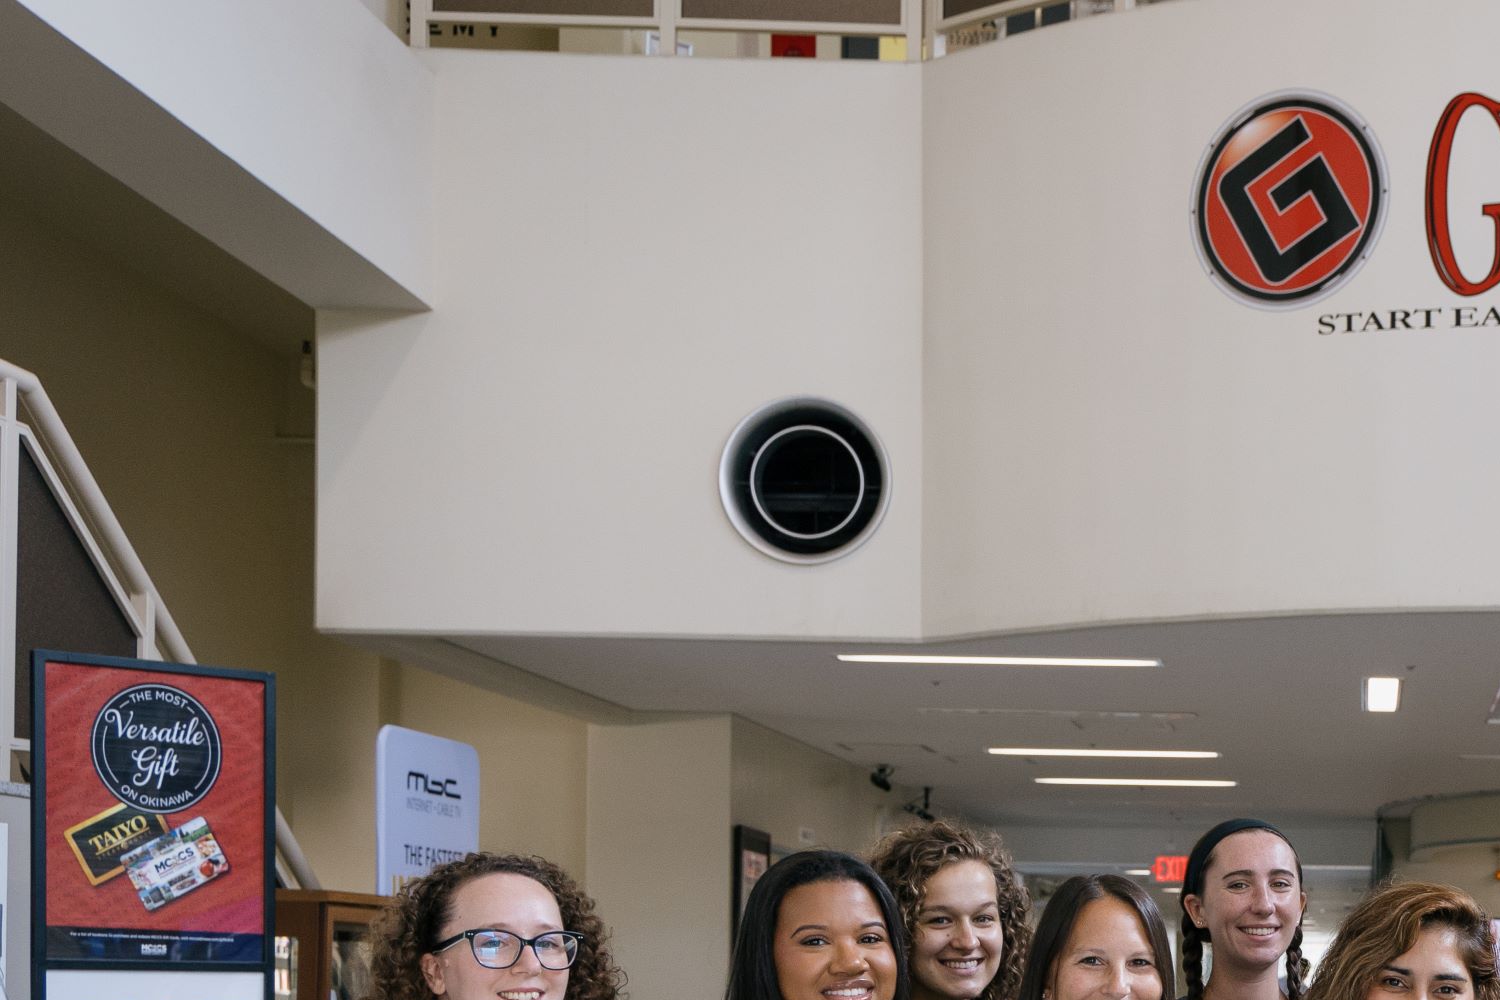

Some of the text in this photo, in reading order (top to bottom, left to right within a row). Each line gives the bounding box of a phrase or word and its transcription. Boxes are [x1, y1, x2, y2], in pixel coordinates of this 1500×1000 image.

[1318, 307, 1441, 335] START
[129, 690, 188, 709] THE MOST
[105, 709, 205, 746] Versatile
[131, 746, 179, 789] Gift
[121, 785, 194, 807] ON OKINAWA
[89, 814, 148, 852] TAIYO
[154, 847, 194, 873] MCCS
[404, 844, 463, 867] THE FASTE
